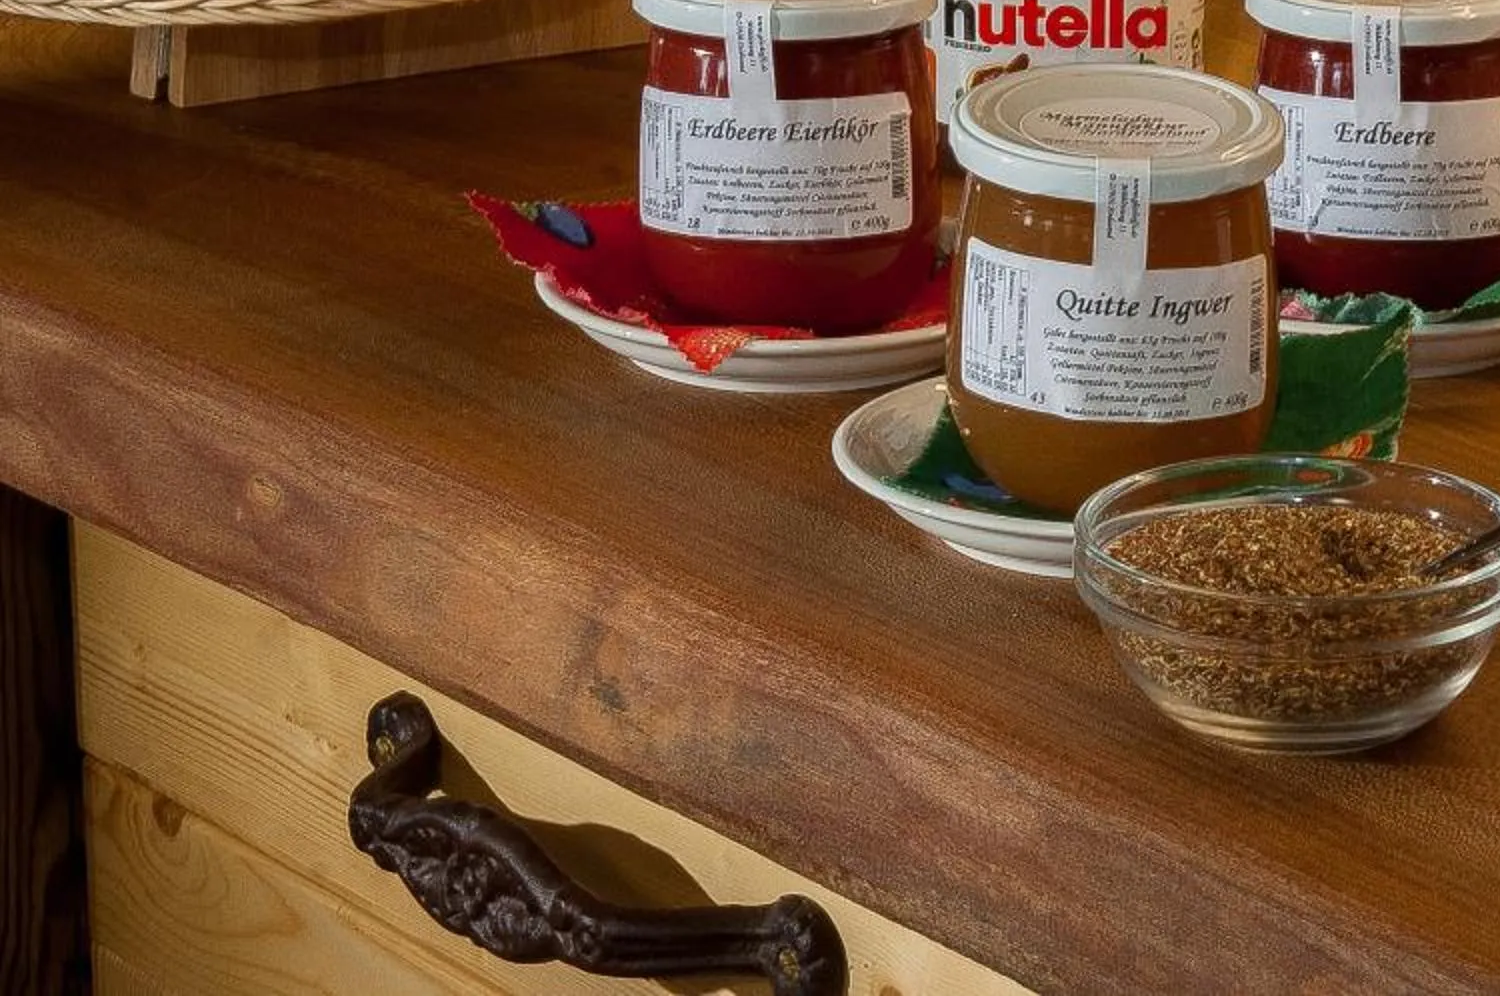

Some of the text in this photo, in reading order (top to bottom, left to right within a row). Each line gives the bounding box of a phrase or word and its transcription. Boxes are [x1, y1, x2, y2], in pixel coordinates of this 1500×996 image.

[687, 116, 880, 143] Erdbeere Eierlikör
[1334, 121, 1437, 146] Erdbeere
[863, 216, 891, 230] 400g
[1056, 289, 1234, 325] Quitte Ingwer
